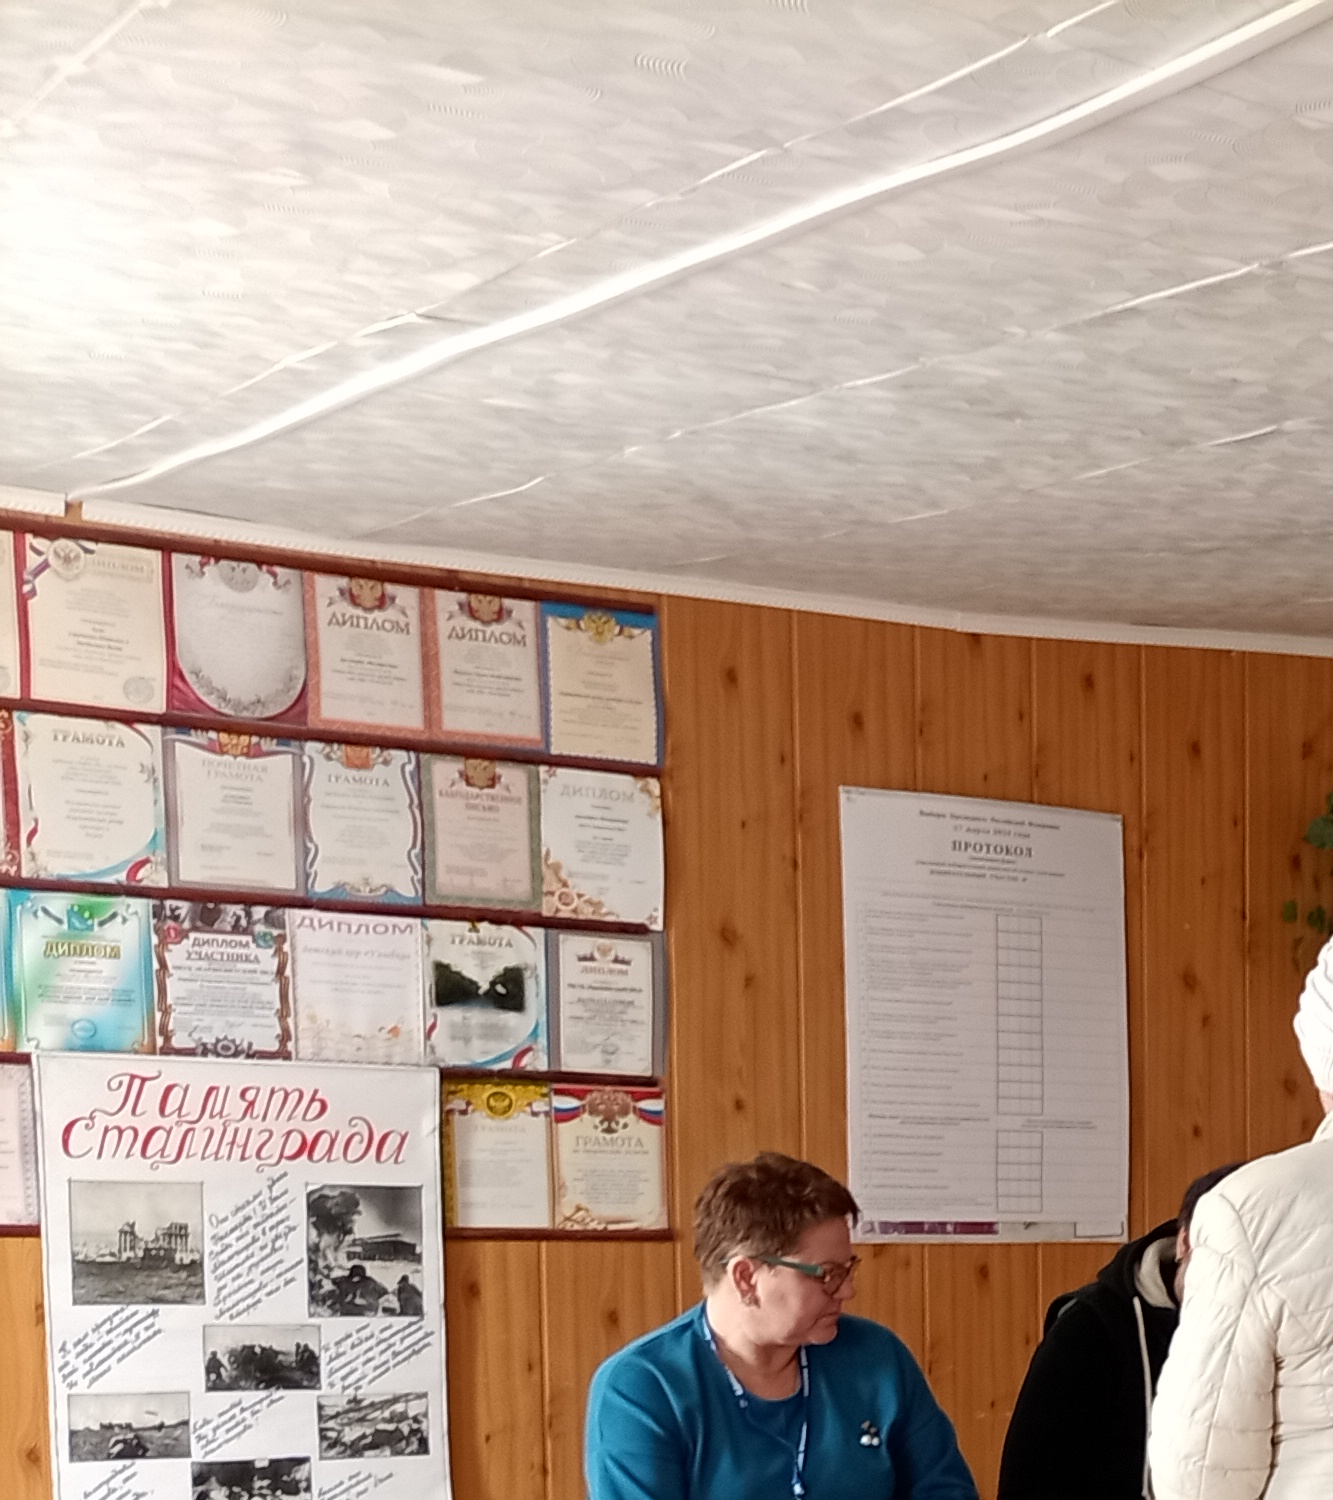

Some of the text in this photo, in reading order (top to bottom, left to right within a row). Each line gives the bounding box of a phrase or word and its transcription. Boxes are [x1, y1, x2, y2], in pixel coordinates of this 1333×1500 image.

[327, 611, 411, 637] ДИПЛОМ
[448, 626, 528, 648] ДИПЛОМ
[52, 729, 126, 749] ГРАМОТА
[327, 772, 391, 788] ГРАМОТА
[560, 784, 637, 803] ДИПЛОМ
[951, 839, 1034, 859] ПРОТОКОЛ
[296, 916, 414, 936] ДИПЛОМ
[44, 940, 121, 960] ДИПЛОМ
[191, 937, 251, 950] ДИПЛОМ
[449, 935, 514, 949] ГРАМОТА
[185, 950, 261, 964] УЧАСТНИКА
[89, 1069, 329, 1127] Память
[60, 1114, 410, 1173] Сталинграда
[575, 1135, 644, 1149] ГРАМОТА
